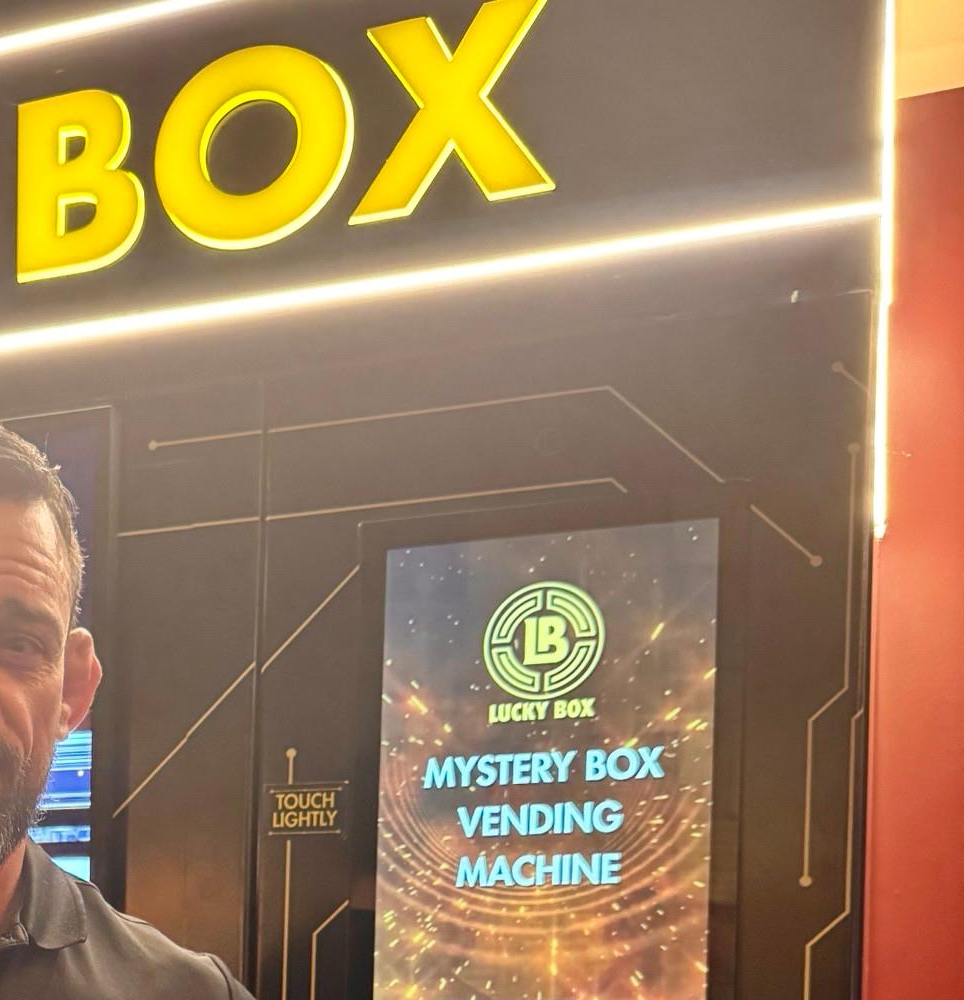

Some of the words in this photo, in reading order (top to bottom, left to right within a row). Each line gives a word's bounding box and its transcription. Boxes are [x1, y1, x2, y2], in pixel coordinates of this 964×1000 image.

[16, 0, 556, 284] BOX
[522, 615, 570, 666] LB
[488, 700, 550, 724] LUCKY
[553, 697, 597, 719] BOX
[422, 750, 578, 790] MYSTERY
[585, 745, 666, 782] BOX
[272, 810, 338, 828] LIGHTLY
[275, 792, 335, 810] TOUCH
[456, 799, 625, 838] VENDING
[454, 852, 623, 888] MACHINE
